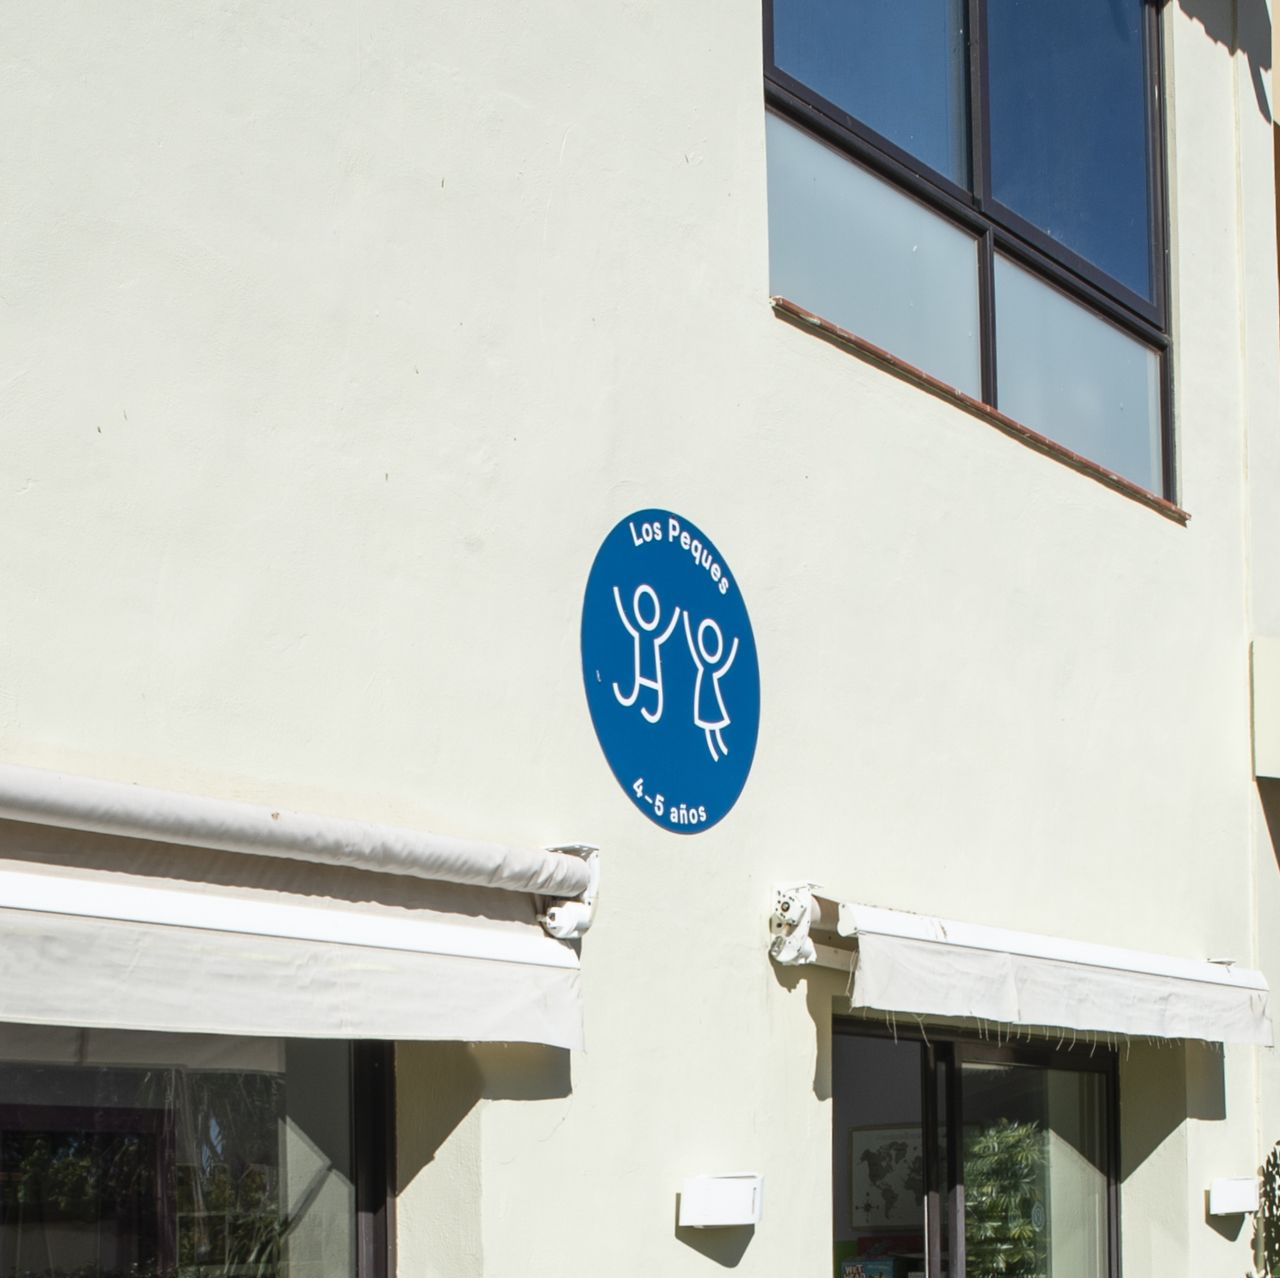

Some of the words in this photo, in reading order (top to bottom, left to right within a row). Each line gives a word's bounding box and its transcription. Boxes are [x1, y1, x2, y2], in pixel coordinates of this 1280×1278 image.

[629, 520, 663, 547] Los
[668, 518, 730, 596] Peques
[669, 804, 707, 825] años
